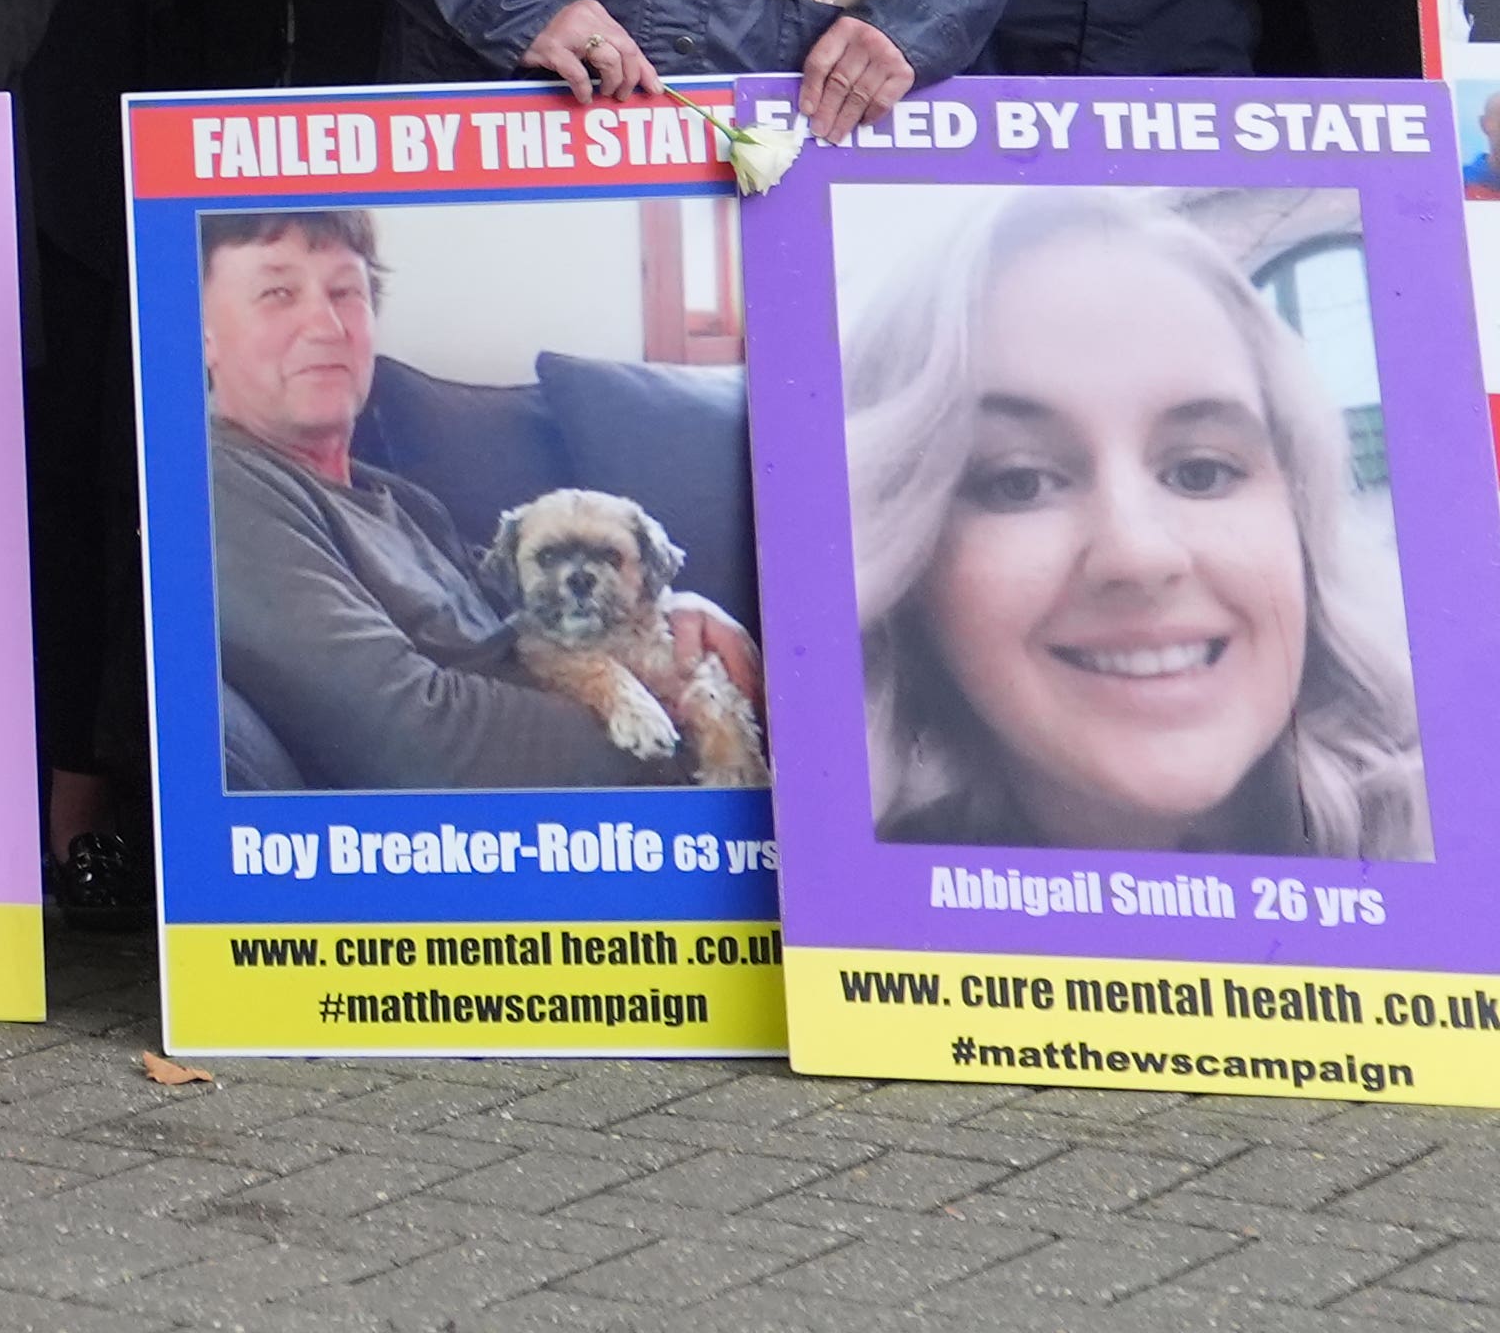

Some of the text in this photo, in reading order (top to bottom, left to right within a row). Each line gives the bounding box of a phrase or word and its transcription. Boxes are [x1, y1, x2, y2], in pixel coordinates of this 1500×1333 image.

[231, 823, 778, 879] Roy Breaker-Rolfe 63 yrs
[930, 866, 1386, 927] Abbigail Smith 26 yrs
[319, 988, 708, 1027] #matthewscampaign
